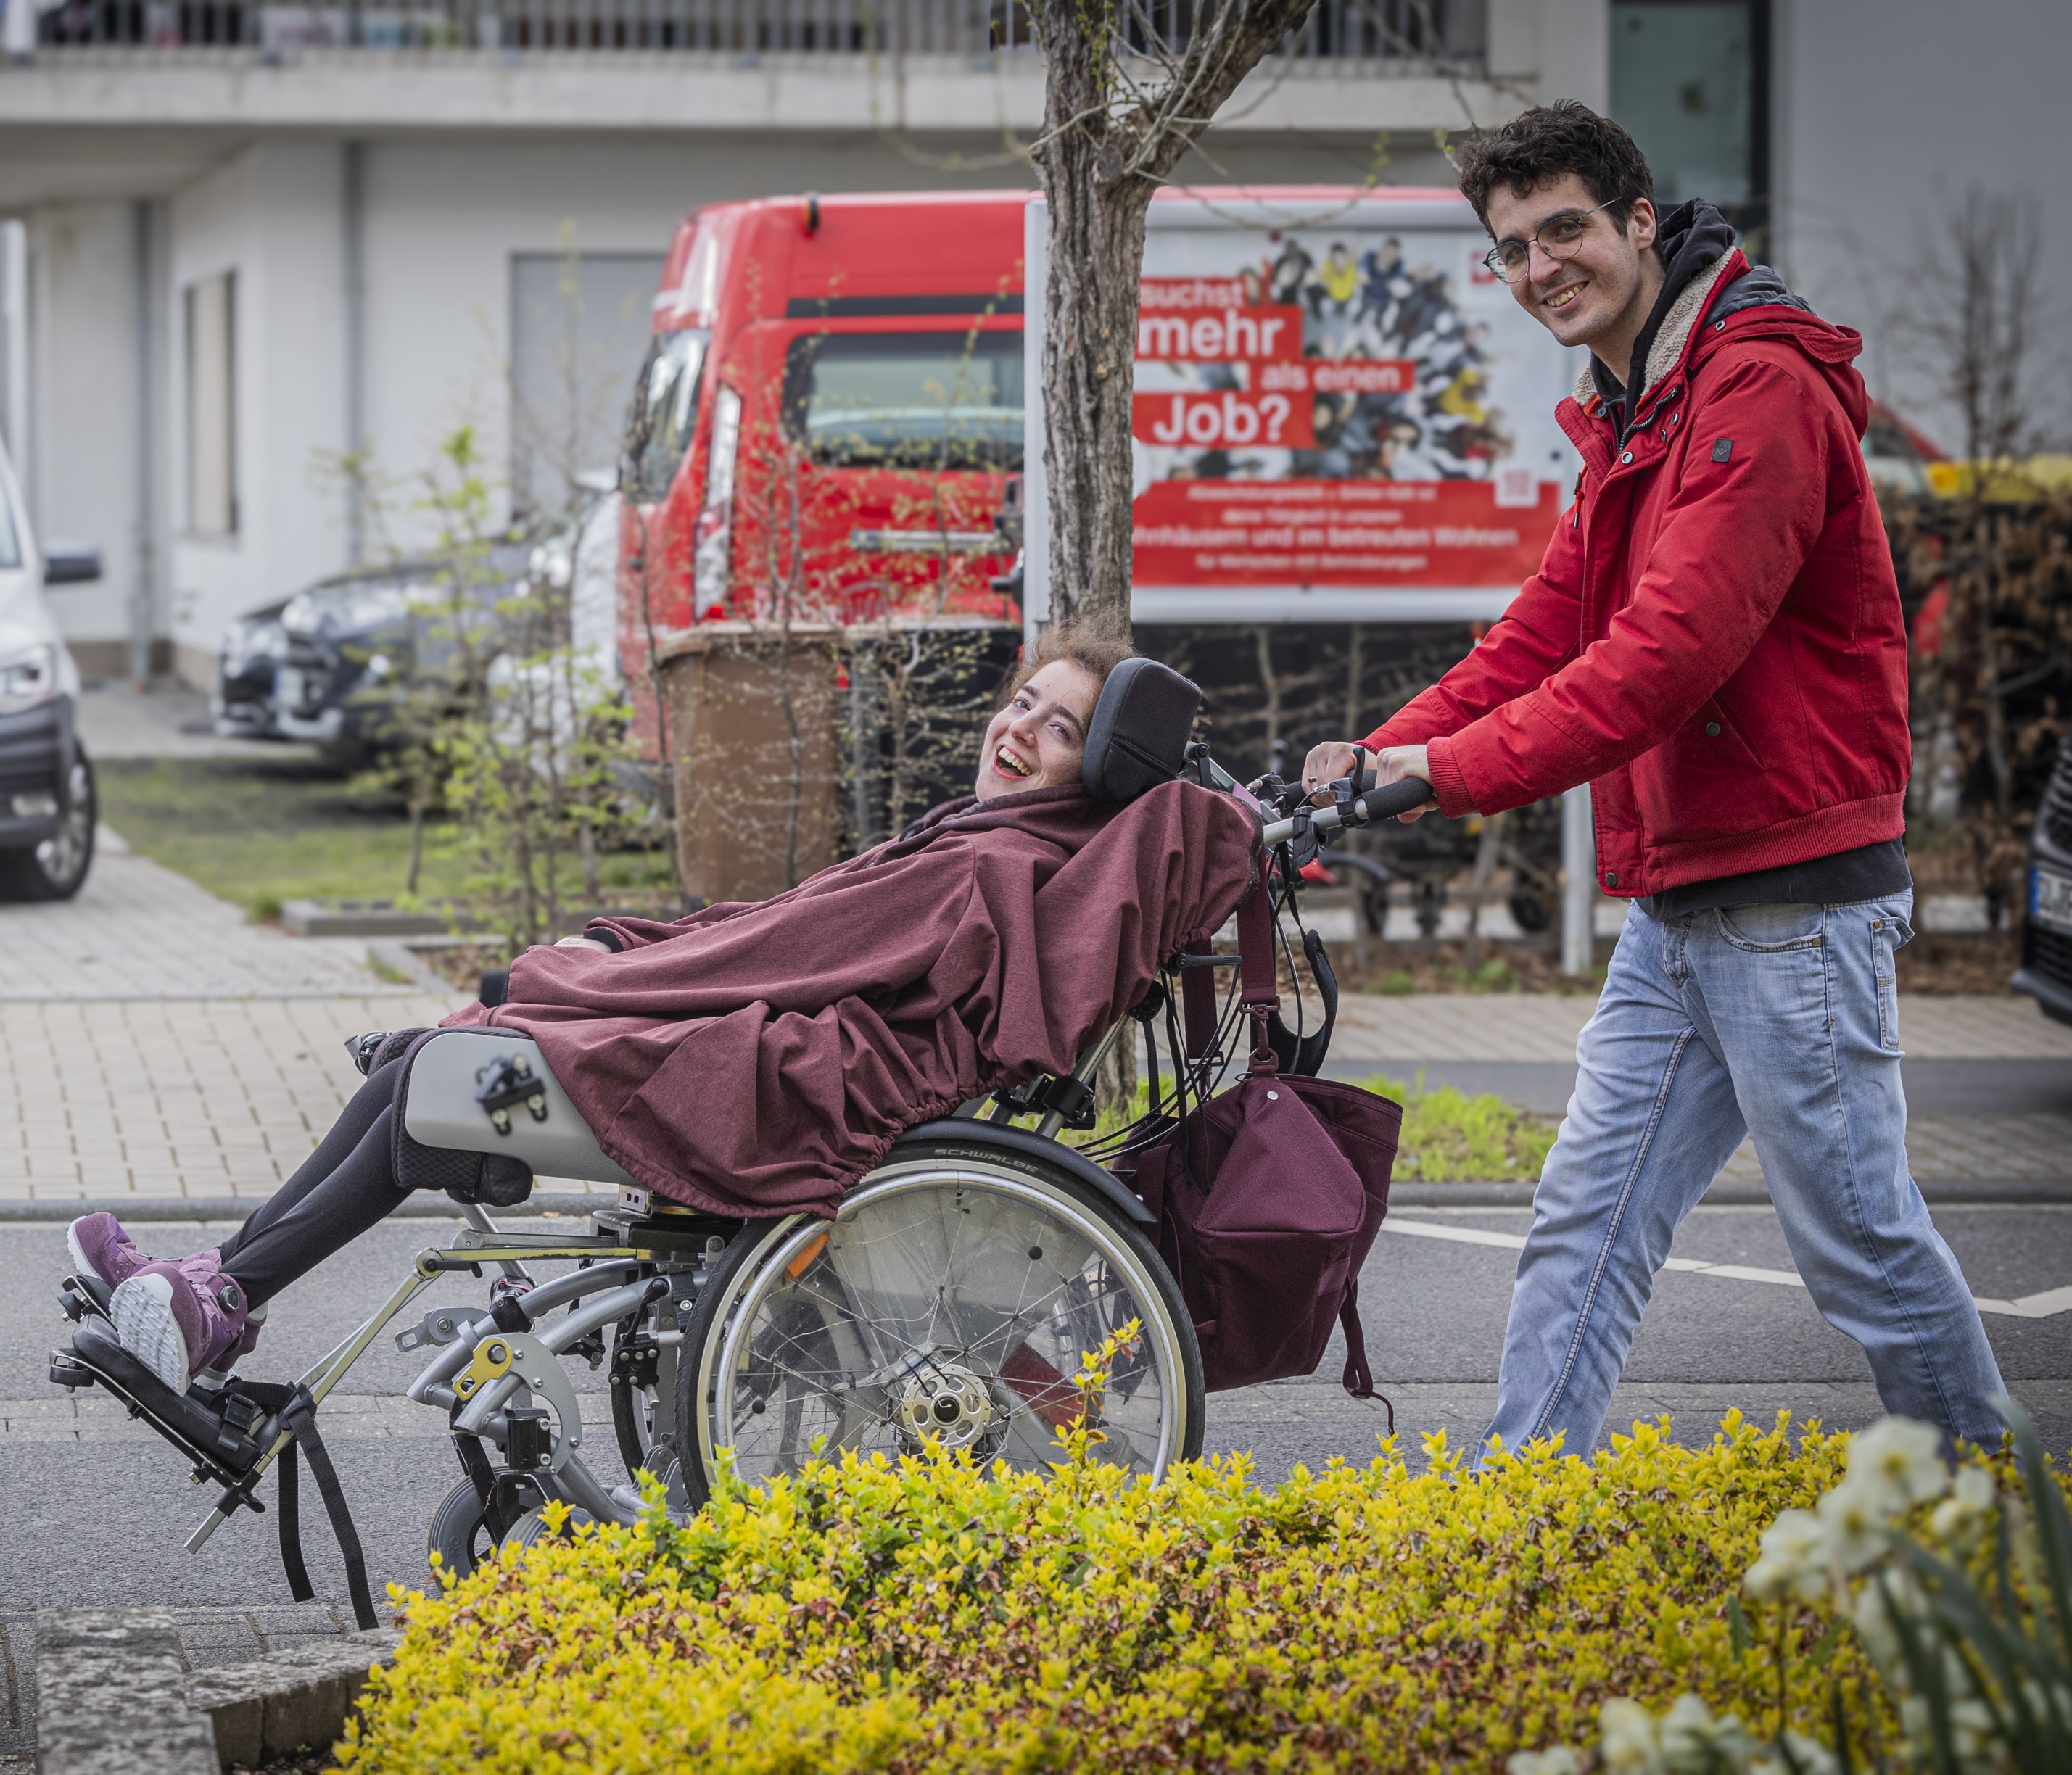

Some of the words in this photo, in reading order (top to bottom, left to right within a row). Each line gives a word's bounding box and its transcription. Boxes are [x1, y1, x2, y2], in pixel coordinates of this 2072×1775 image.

[1140, 281, 1245, 308] suchst
[1137, 308, 1284, 357] mehr
[1261, 362, 1308, 390] als
[1313, 363, 1400, 390] einen
[1152, 393, 1290, 443] Job?
[1252, 528, 1295, 547] und
[1433, 527, 1519, 547] Wohnen
[934, 1149, 1038, 1172] SCHWALBE
